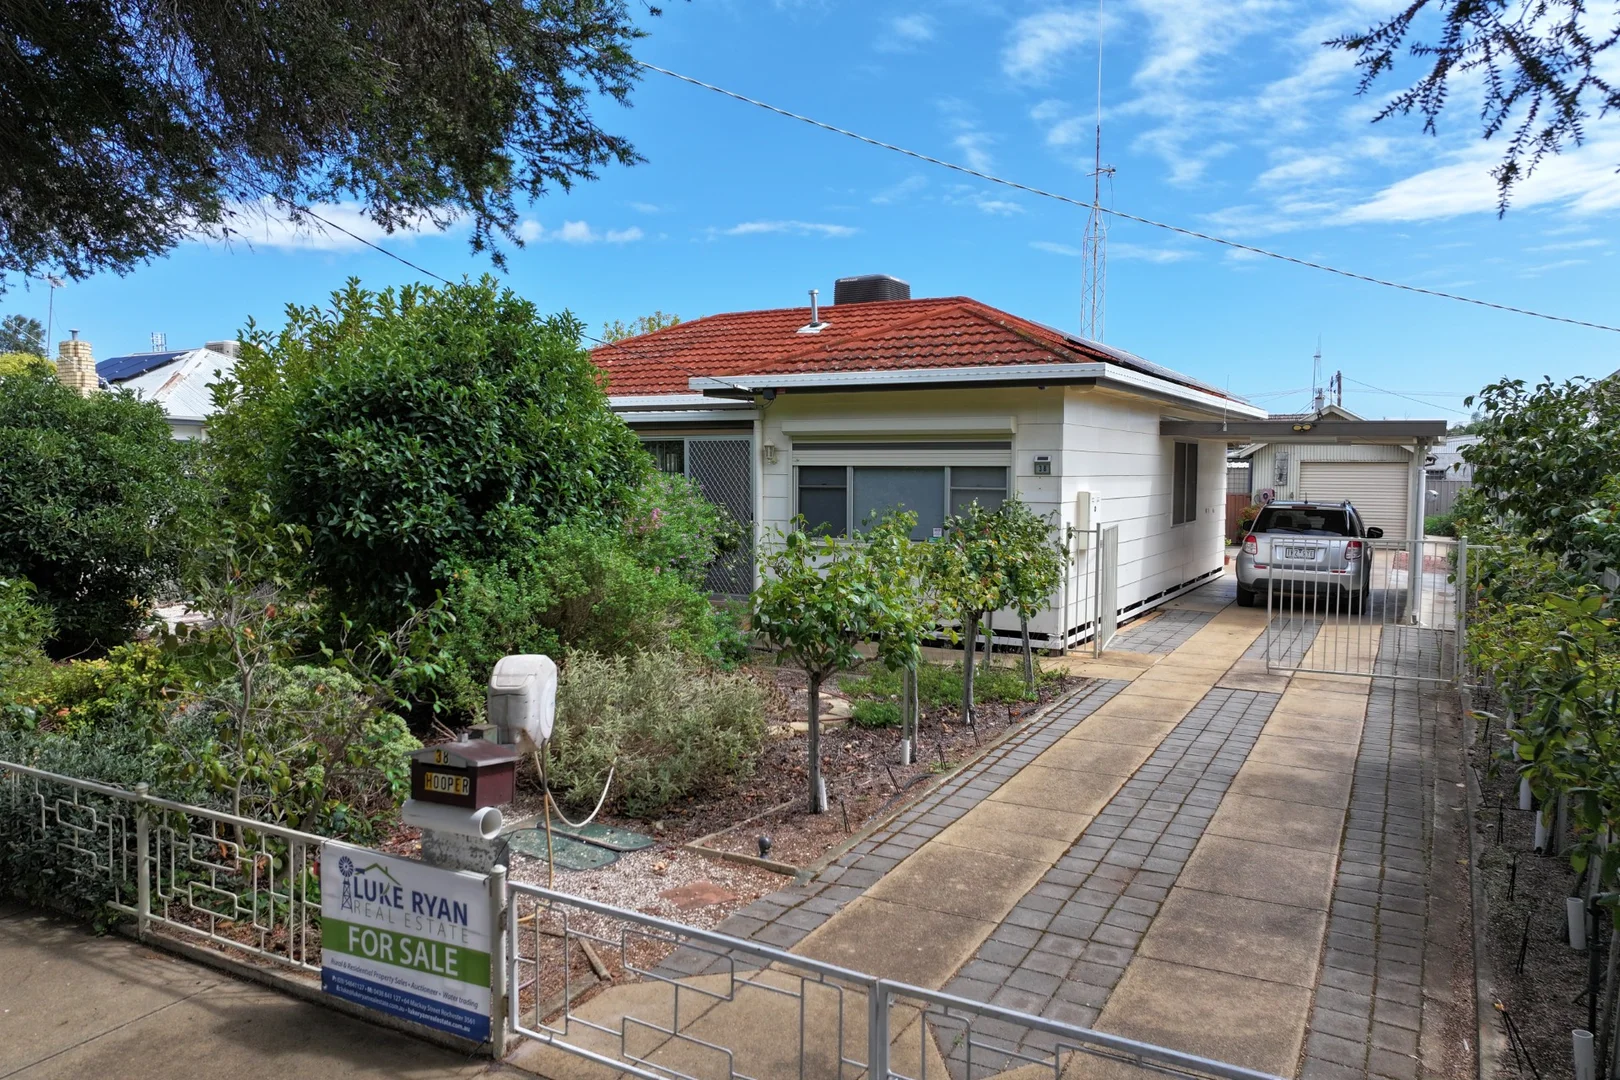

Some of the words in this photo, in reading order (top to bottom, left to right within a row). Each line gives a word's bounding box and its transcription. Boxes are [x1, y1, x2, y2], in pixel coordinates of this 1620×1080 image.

[436, 749, 449, 764] 38
[426, 773, 469, 794] HOOPER
[353, 899, 395, 925] REAL
[405, 912, 469, 944] ESTATE
[354, 876, 404, 910] LUKE
[412, 890, 468, 926] RYAN
[349, 925, 394, 961] FOR
[400, 937, 459, 977] SALE
[331, 957, 343, 967] Rural
[347, 963, 373, 976] Residential
[374, 970, 394, 984] Property
[395, 977, 407, 987] Sales
[411, 982, 438, 996] Auctioneer
[443, 991, 458, 1002] Water
[459, 998, 479, 1010] trading
[410, 999, 427, 1011] Mackay
[427, 1004, 441, 1014] Street
[441, 1009, 463, 1021] Rochester
